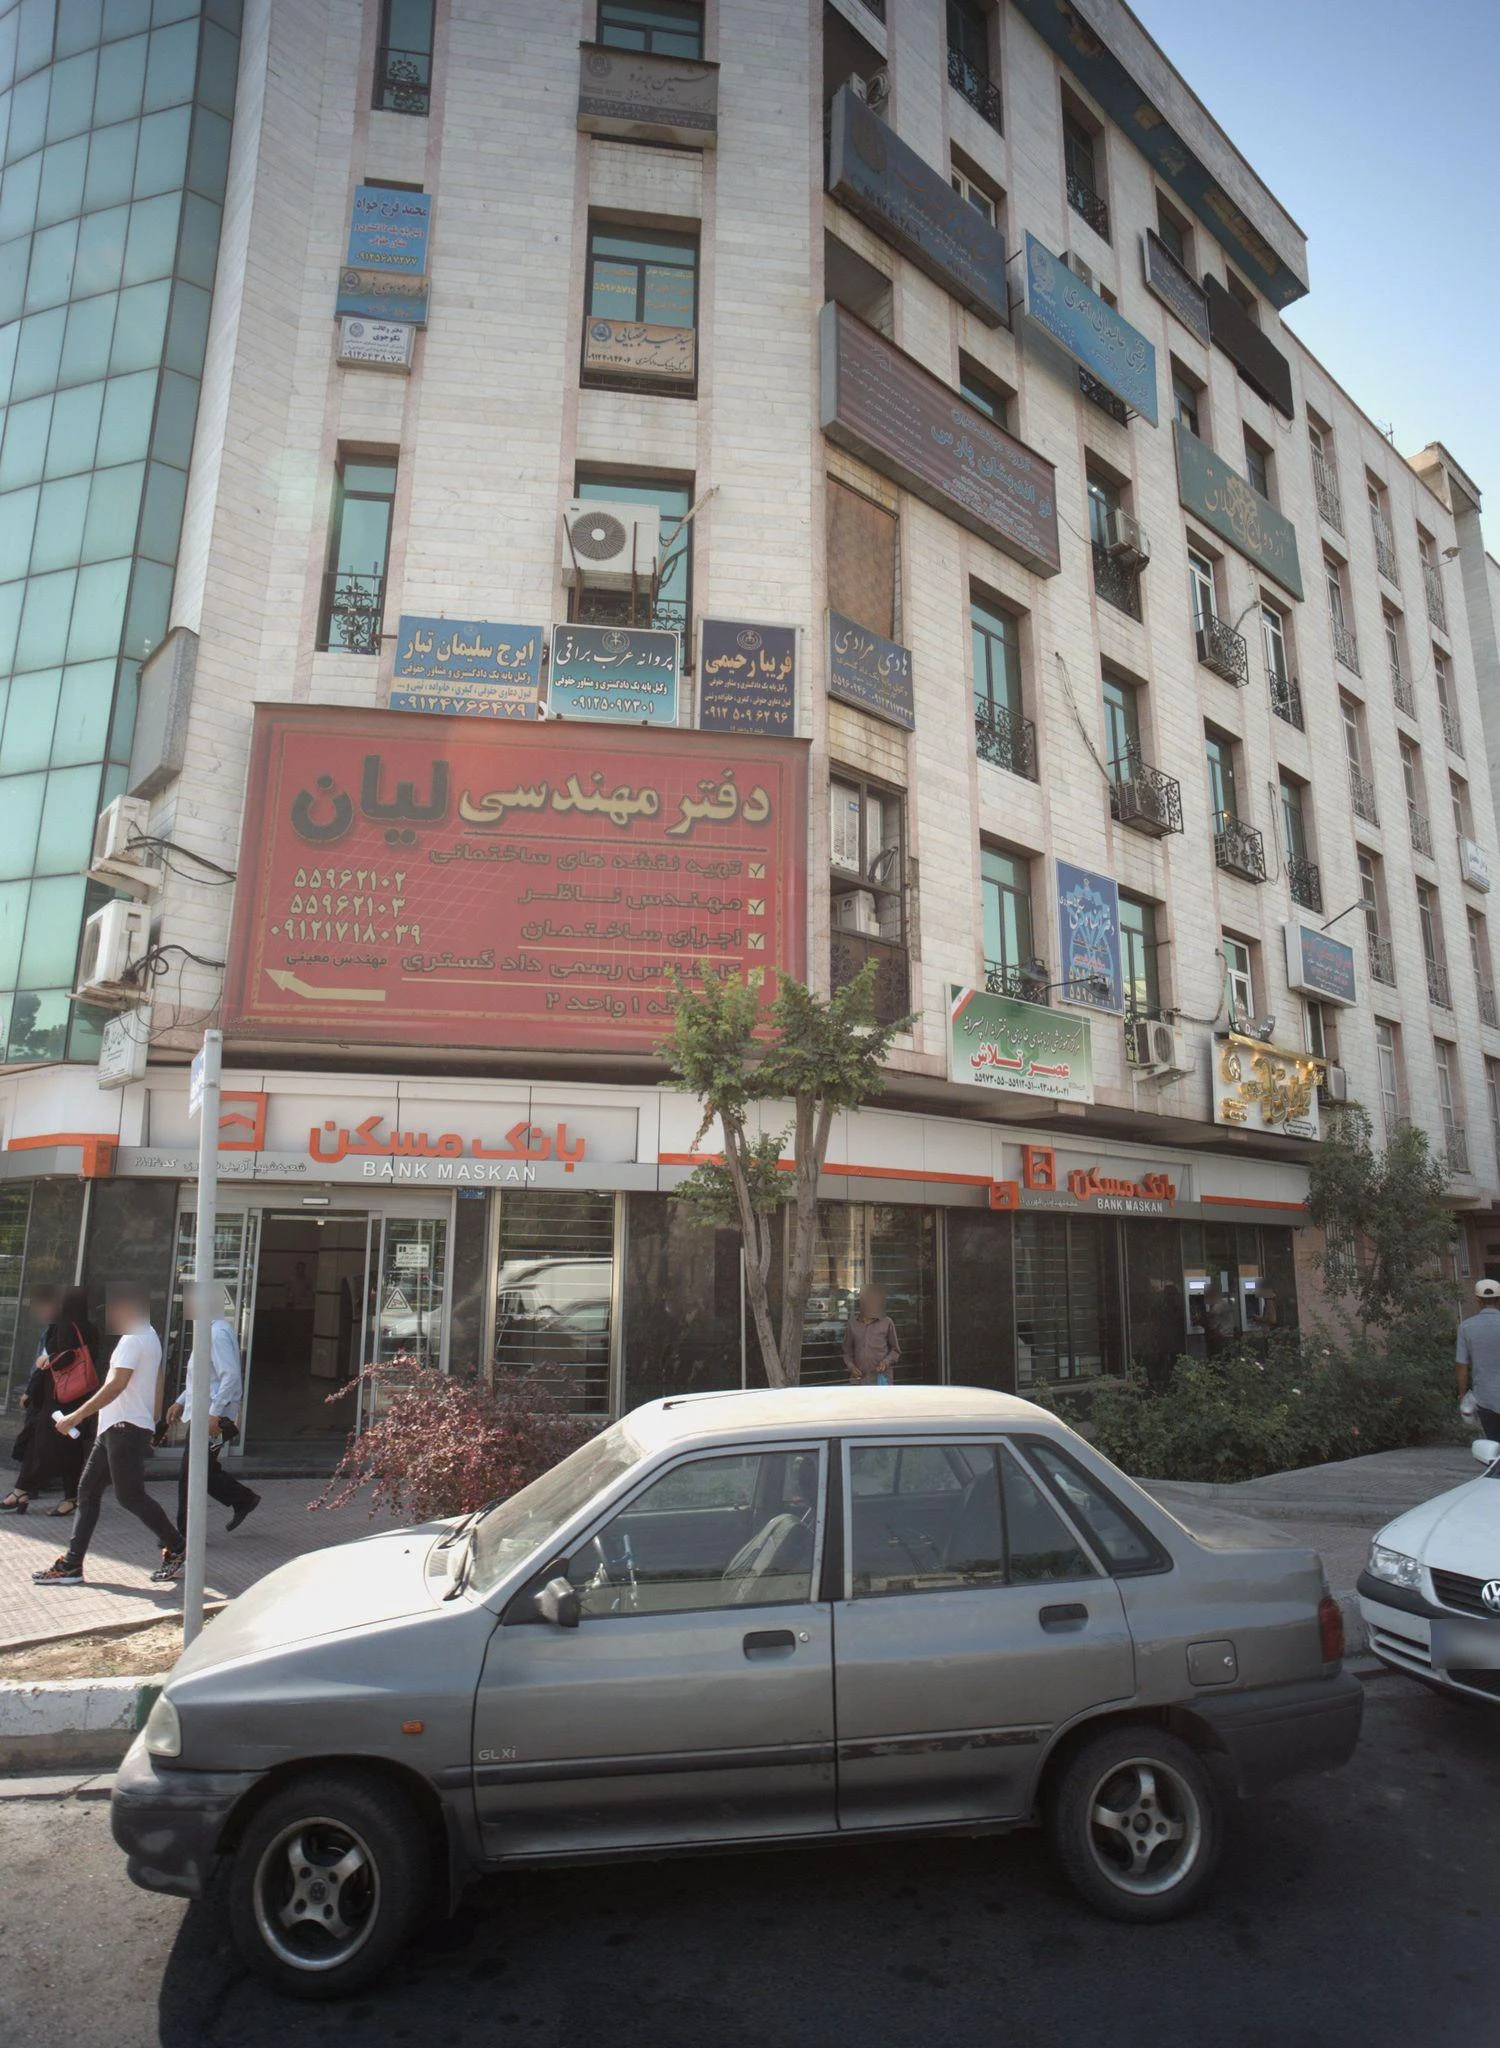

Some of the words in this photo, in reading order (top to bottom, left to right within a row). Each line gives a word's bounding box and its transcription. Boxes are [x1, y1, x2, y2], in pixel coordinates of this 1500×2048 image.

[402, 630, 435, 660] تبار
[436, 633, 493, 662] سلیمان
[496, 639, 535, 667] ایرج
[594, 651, 634, 669] عرب
[636, 651, 673, 671] پروانه
[705, 653, 756, 678] رحیمی
[759, 649, 793, 680] فریبا
[600, 679, 630, 691] دادگستری
[652, 680, 668, 695] وکیل
[290, 755, 450, 846] لیان
[459, 773, 660, 827] مهندسی
[667, 770, 771, 837] دفتر
[430, 844, 551, 866] ساختمانی
[557, 851, 605, 871] های
[612, 854, 680, 872] نقشه
[293, 868, 407, 892] ۵۵۹۶۲۱۰۲
[686, 859, 743, 879] تهیه
[289, 894, 406, 918] ۵۵۹۶۲۱۰۳
[518, 884, 622, 904] ناظر
[626, 892, 743, 914] مهندس
[270, 919, 422, 945] ۰۹۱۲۱۷۱۸۰۳۹
[521, 918, 663, 942] ساختمان
[667, 926, 742, 950] اجرای
[333, 955, 388, 968] مهندس
[550, 961, 623, 981] رسمی
[565, 993, 627, 1018] واحد
[969, 1041, 1024, 1069] تلاش
[1026, 1061, 1070, 1079] عصر
[308, 1115, 464, 1164] مسکن
[471, 1121, 586, 1173] بانک
[363, 1161, 427, 1179] BANK
[436, 1162, 537, 1181] MASKAN
[1068, 1167, 1136, 1201] مسکن
[1136, 1172, 1177, 1207] بانک
[1097, 1197, 1123, 1212] BANK
[1125, 1199, 1164, 1214] MASKAN
[478, 1745, 516, 1761] GLXi
